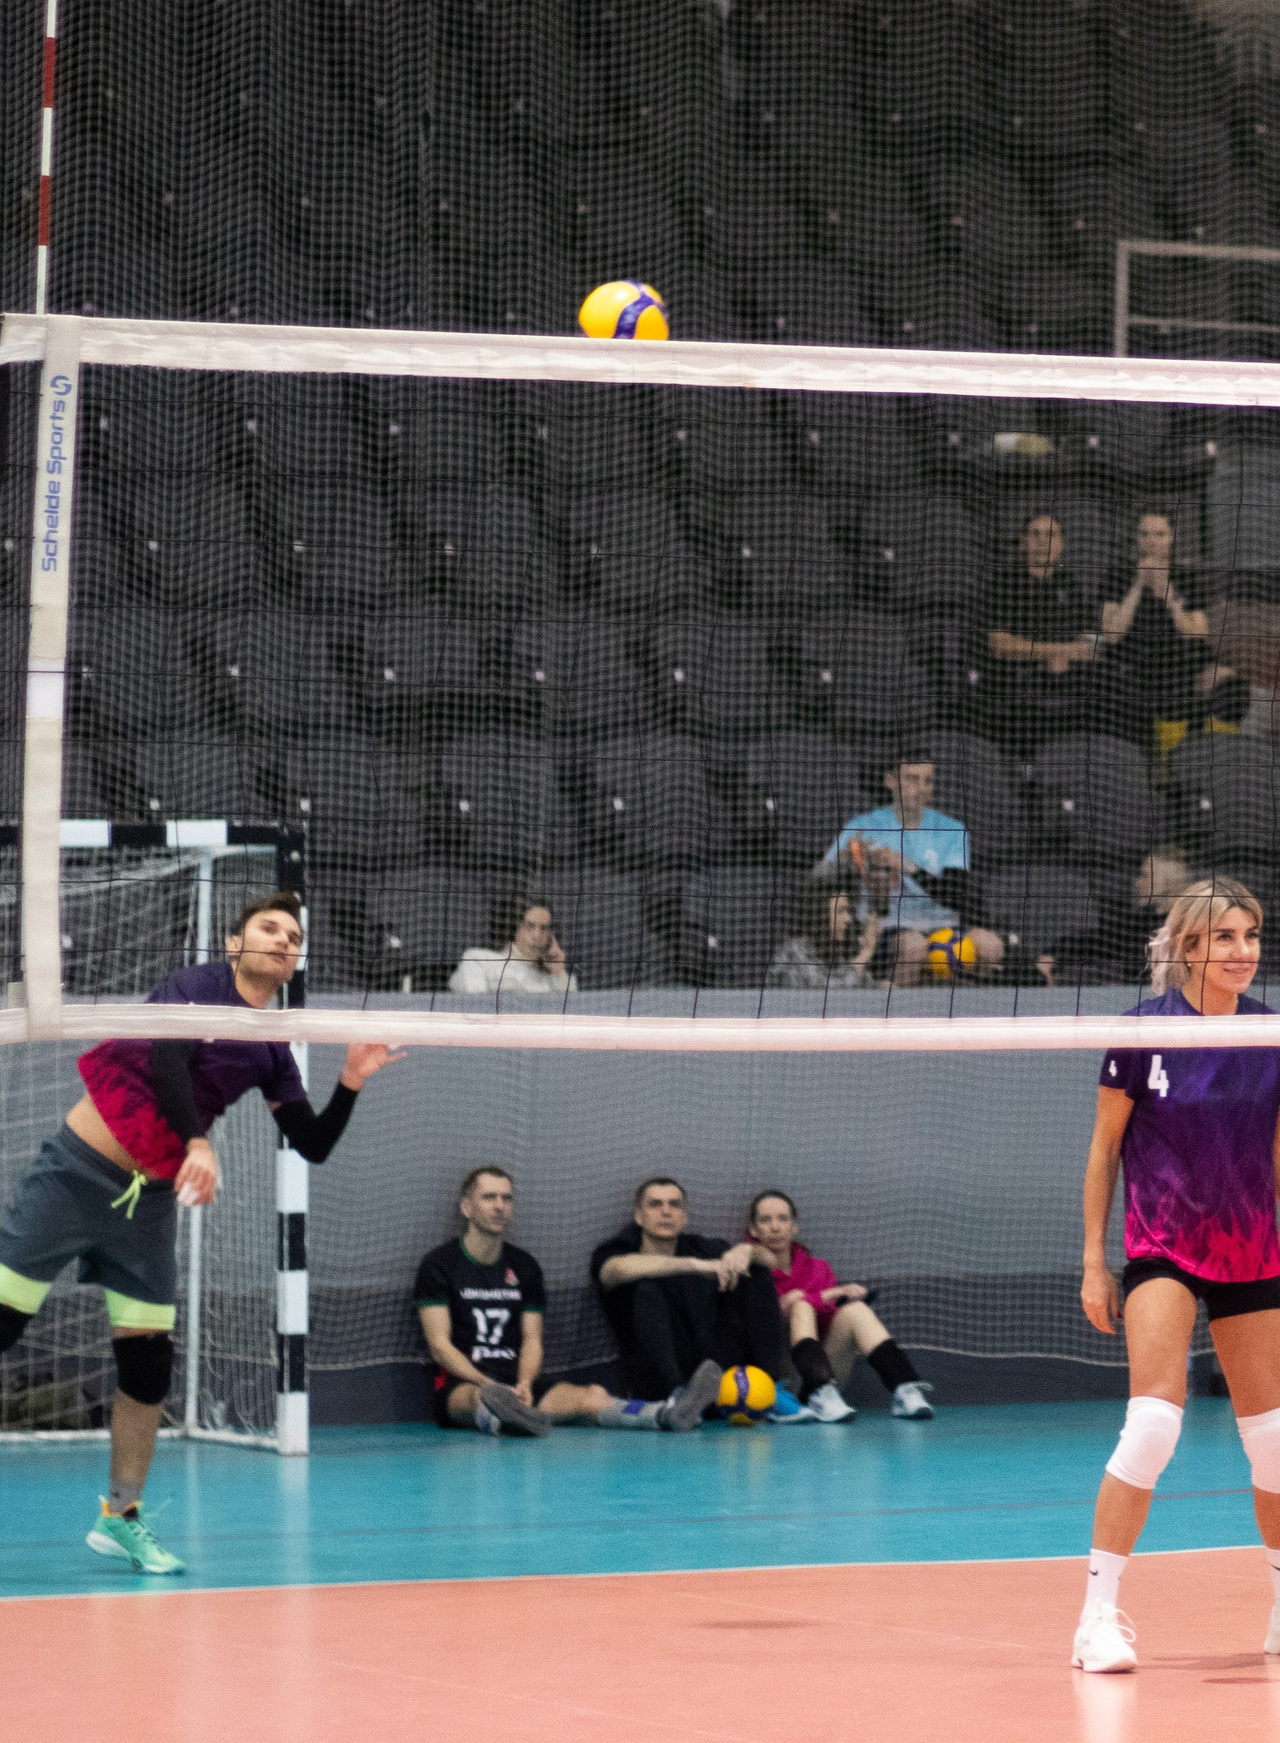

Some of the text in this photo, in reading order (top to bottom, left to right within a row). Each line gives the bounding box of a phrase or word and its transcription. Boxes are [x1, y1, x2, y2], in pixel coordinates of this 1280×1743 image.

[41, 399, 67, 572] Schelde Sports
[1147, 1054, 1169, 1097] 4
[471, 1307, 511, 1345] 17
